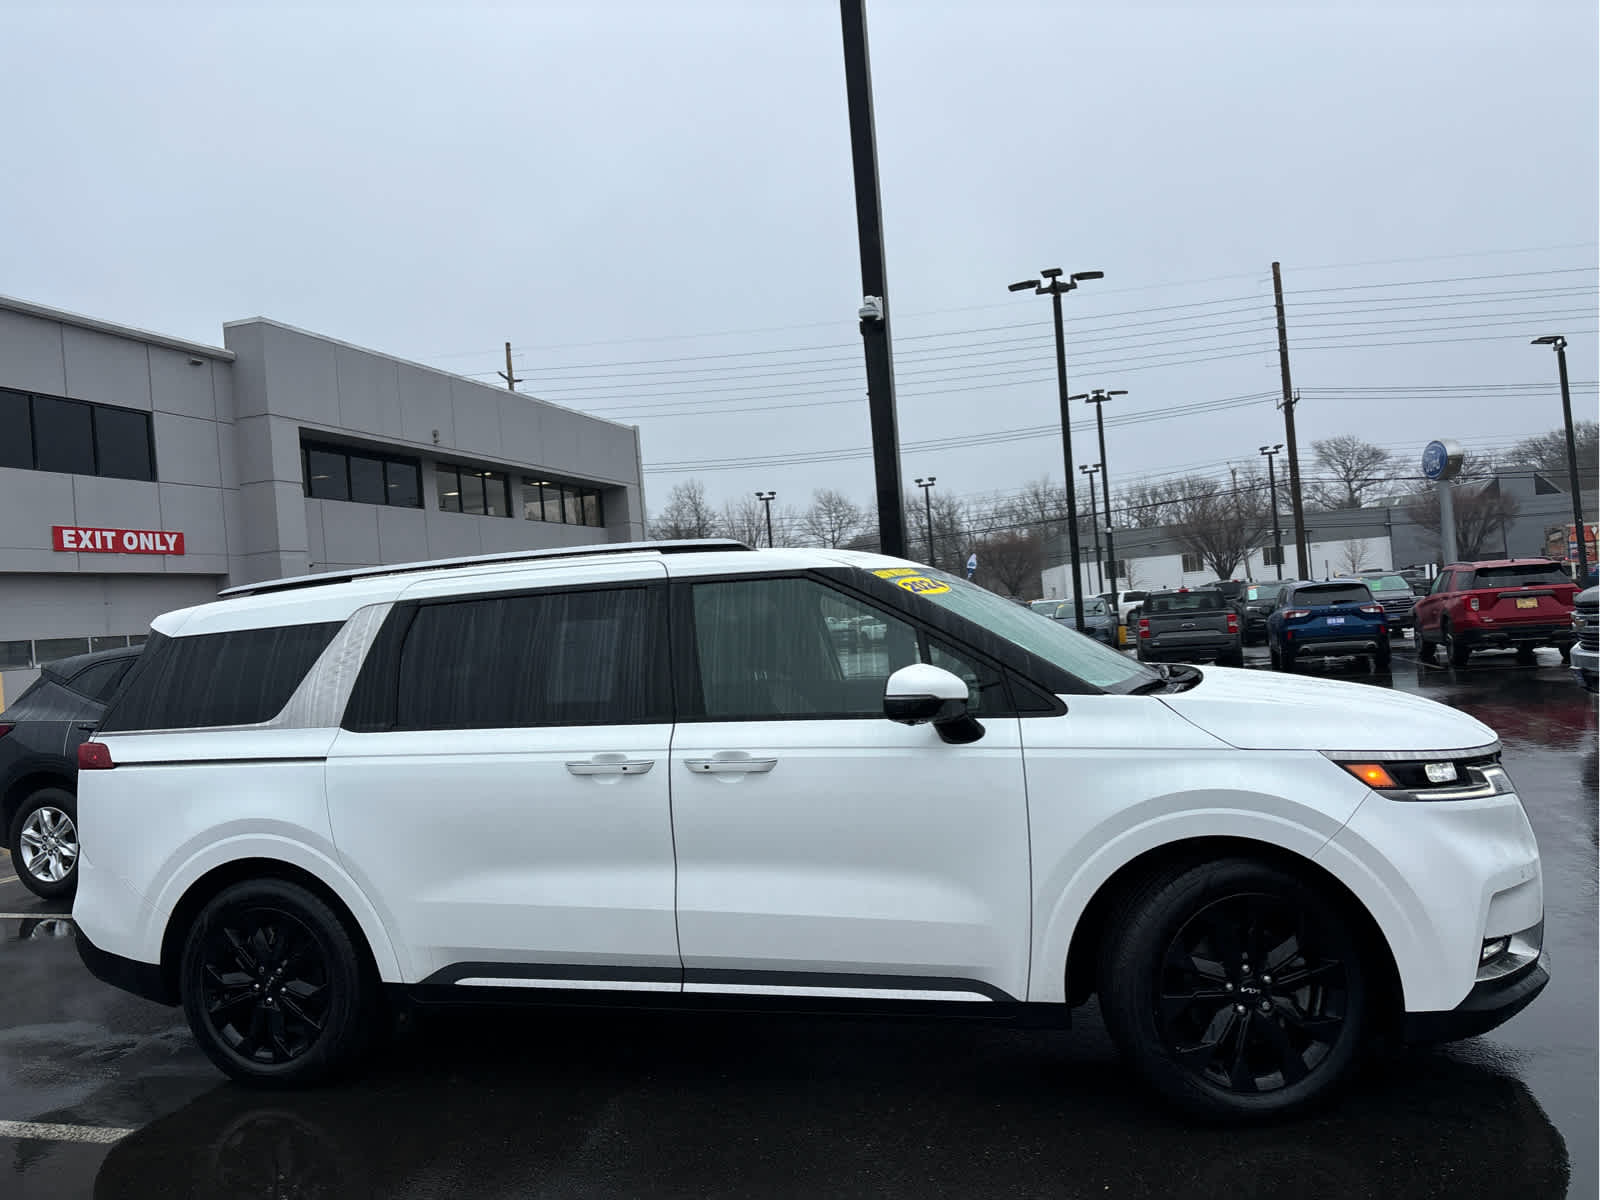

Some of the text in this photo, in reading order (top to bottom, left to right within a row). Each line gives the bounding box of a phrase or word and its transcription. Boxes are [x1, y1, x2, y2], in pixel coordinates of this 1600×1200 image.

[62, 529, 178, 551] EXIT ONLY
[901, 579, 949, 593] 2024
